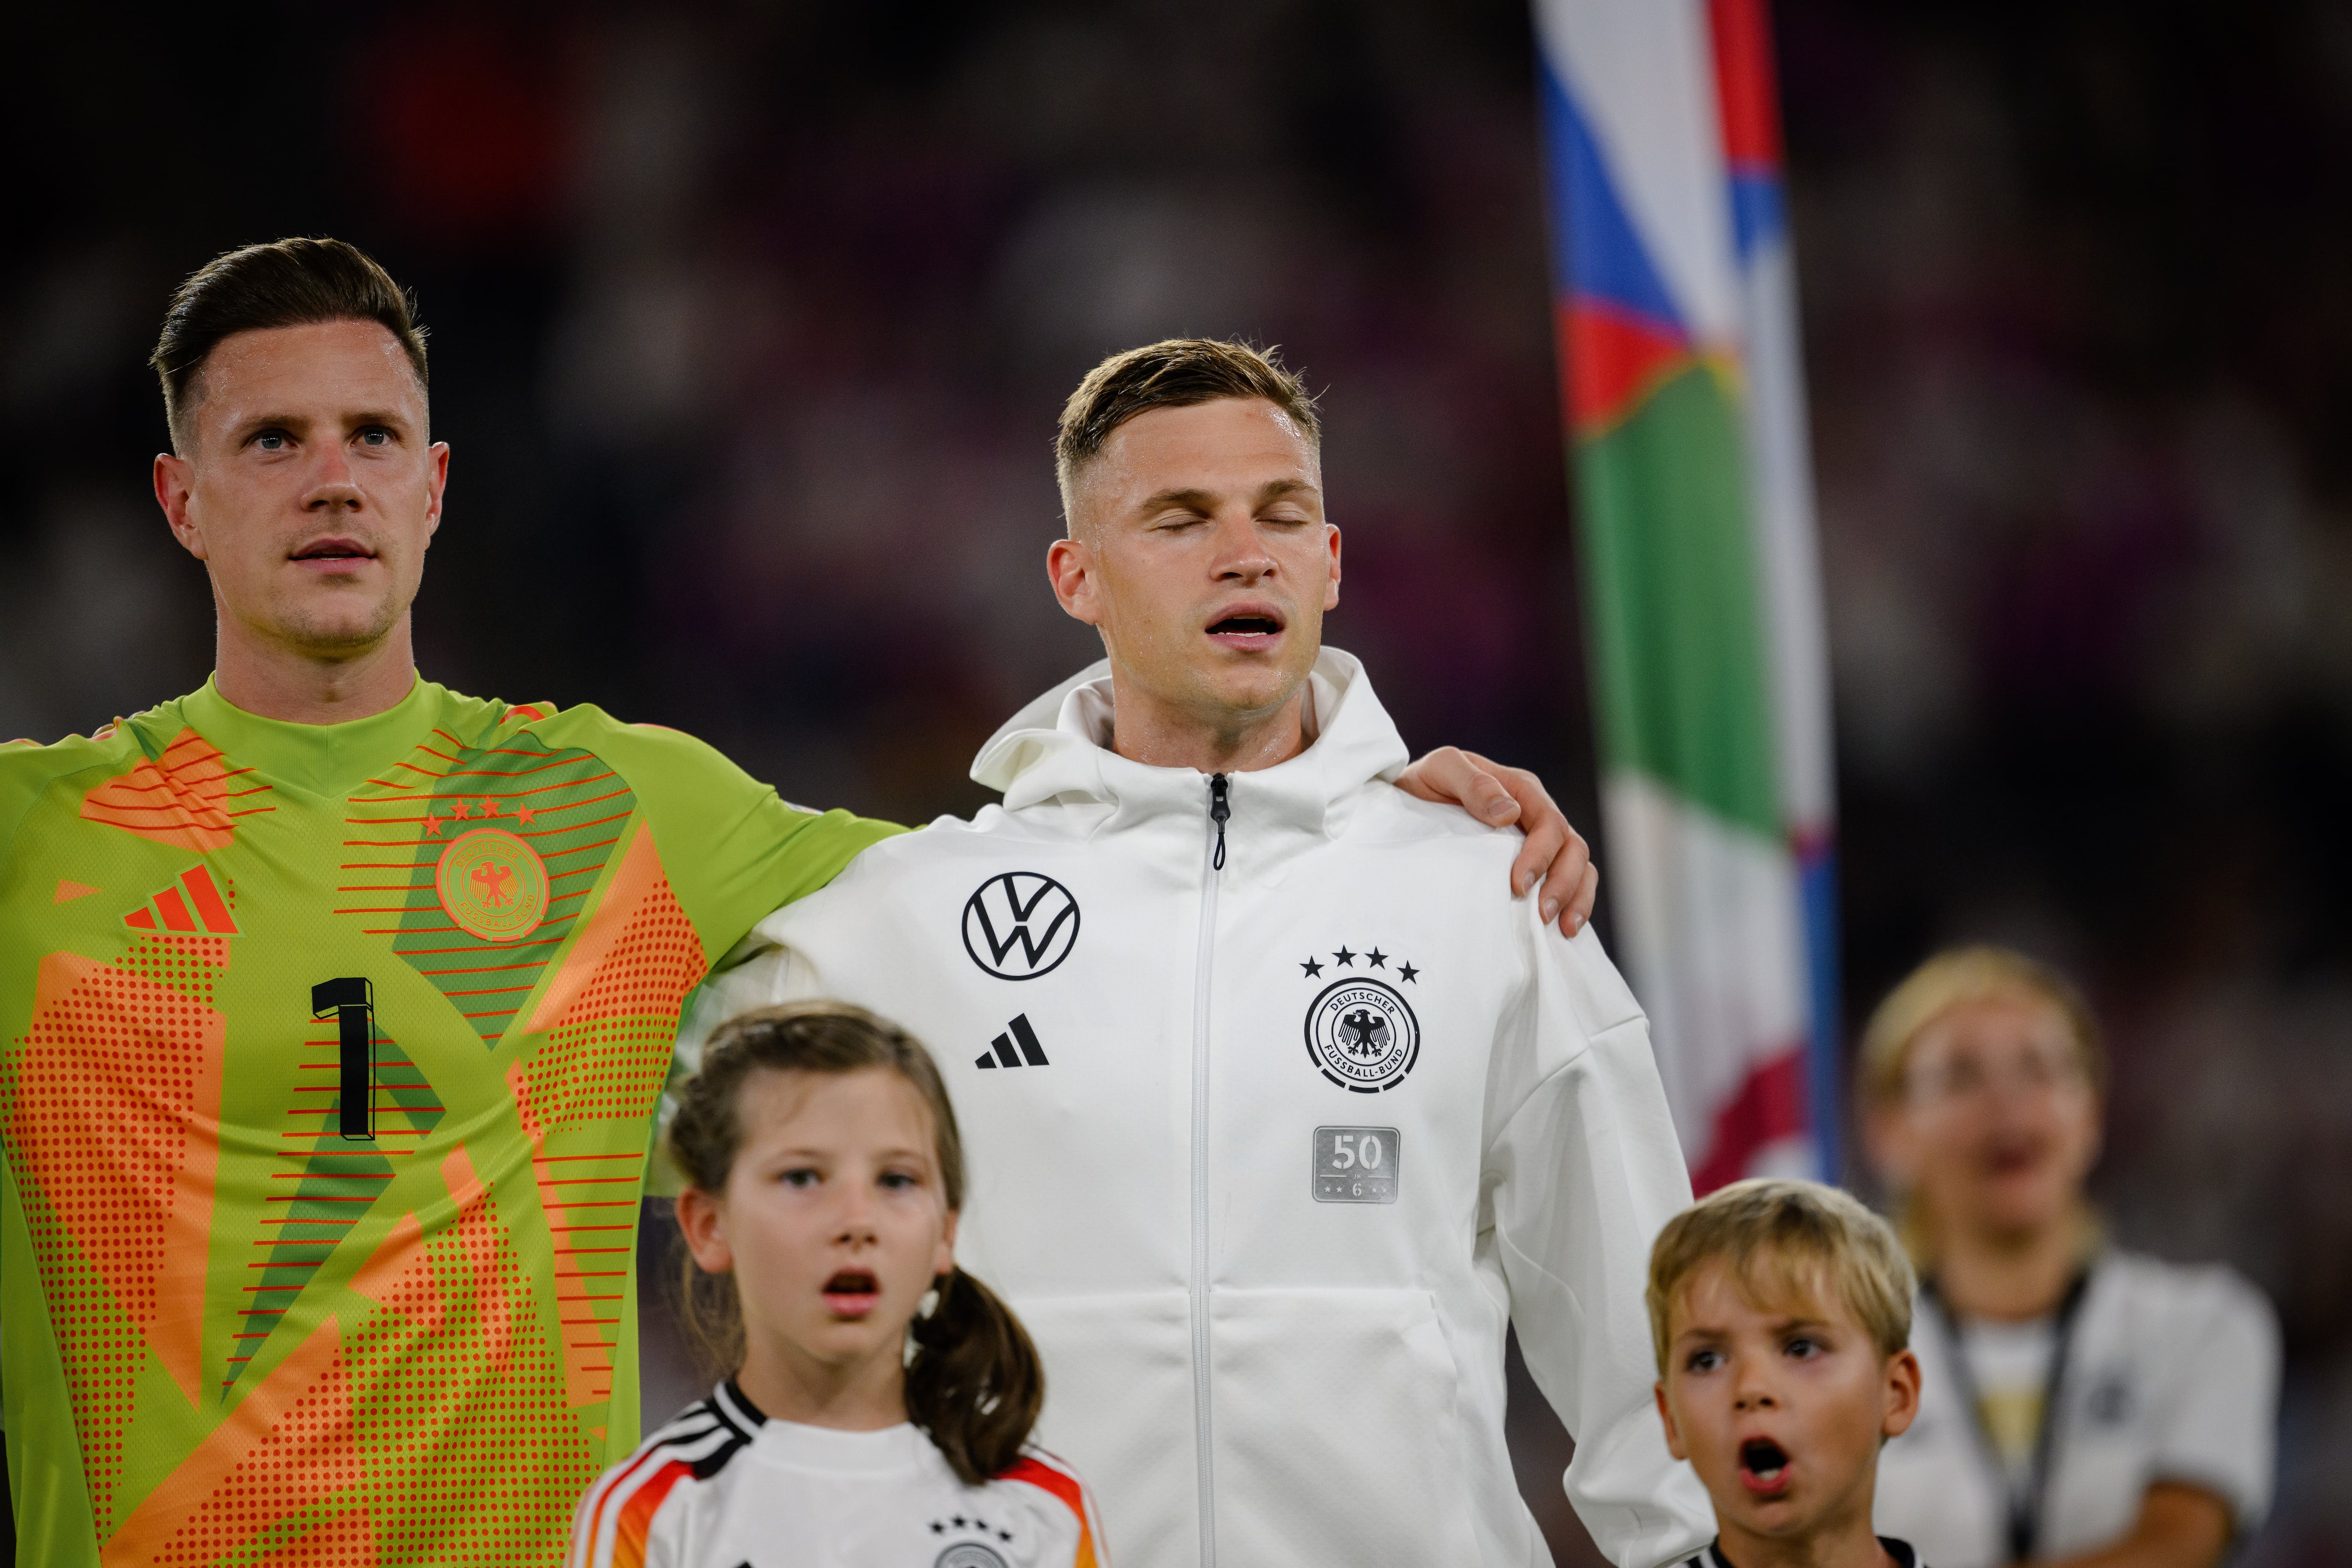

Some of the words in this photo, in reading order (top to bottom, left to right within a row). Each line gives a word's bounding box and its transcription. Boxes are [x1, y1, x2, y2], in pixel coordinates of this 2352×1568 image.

[455, 844, 518, 868] DEUTSCHER
[459, 893, 535, 927] FUSSBALL-BUND
[1330, 992, 1395, 1014] DEUTSCHER
[311, 977, 375, 1141] 1
[1325, 1044, 1402, 1077] FUSSBALL-BUND
[1332, 1135, 1382, 1170] 50
[1352, 1183, 1362, 1196] 6
